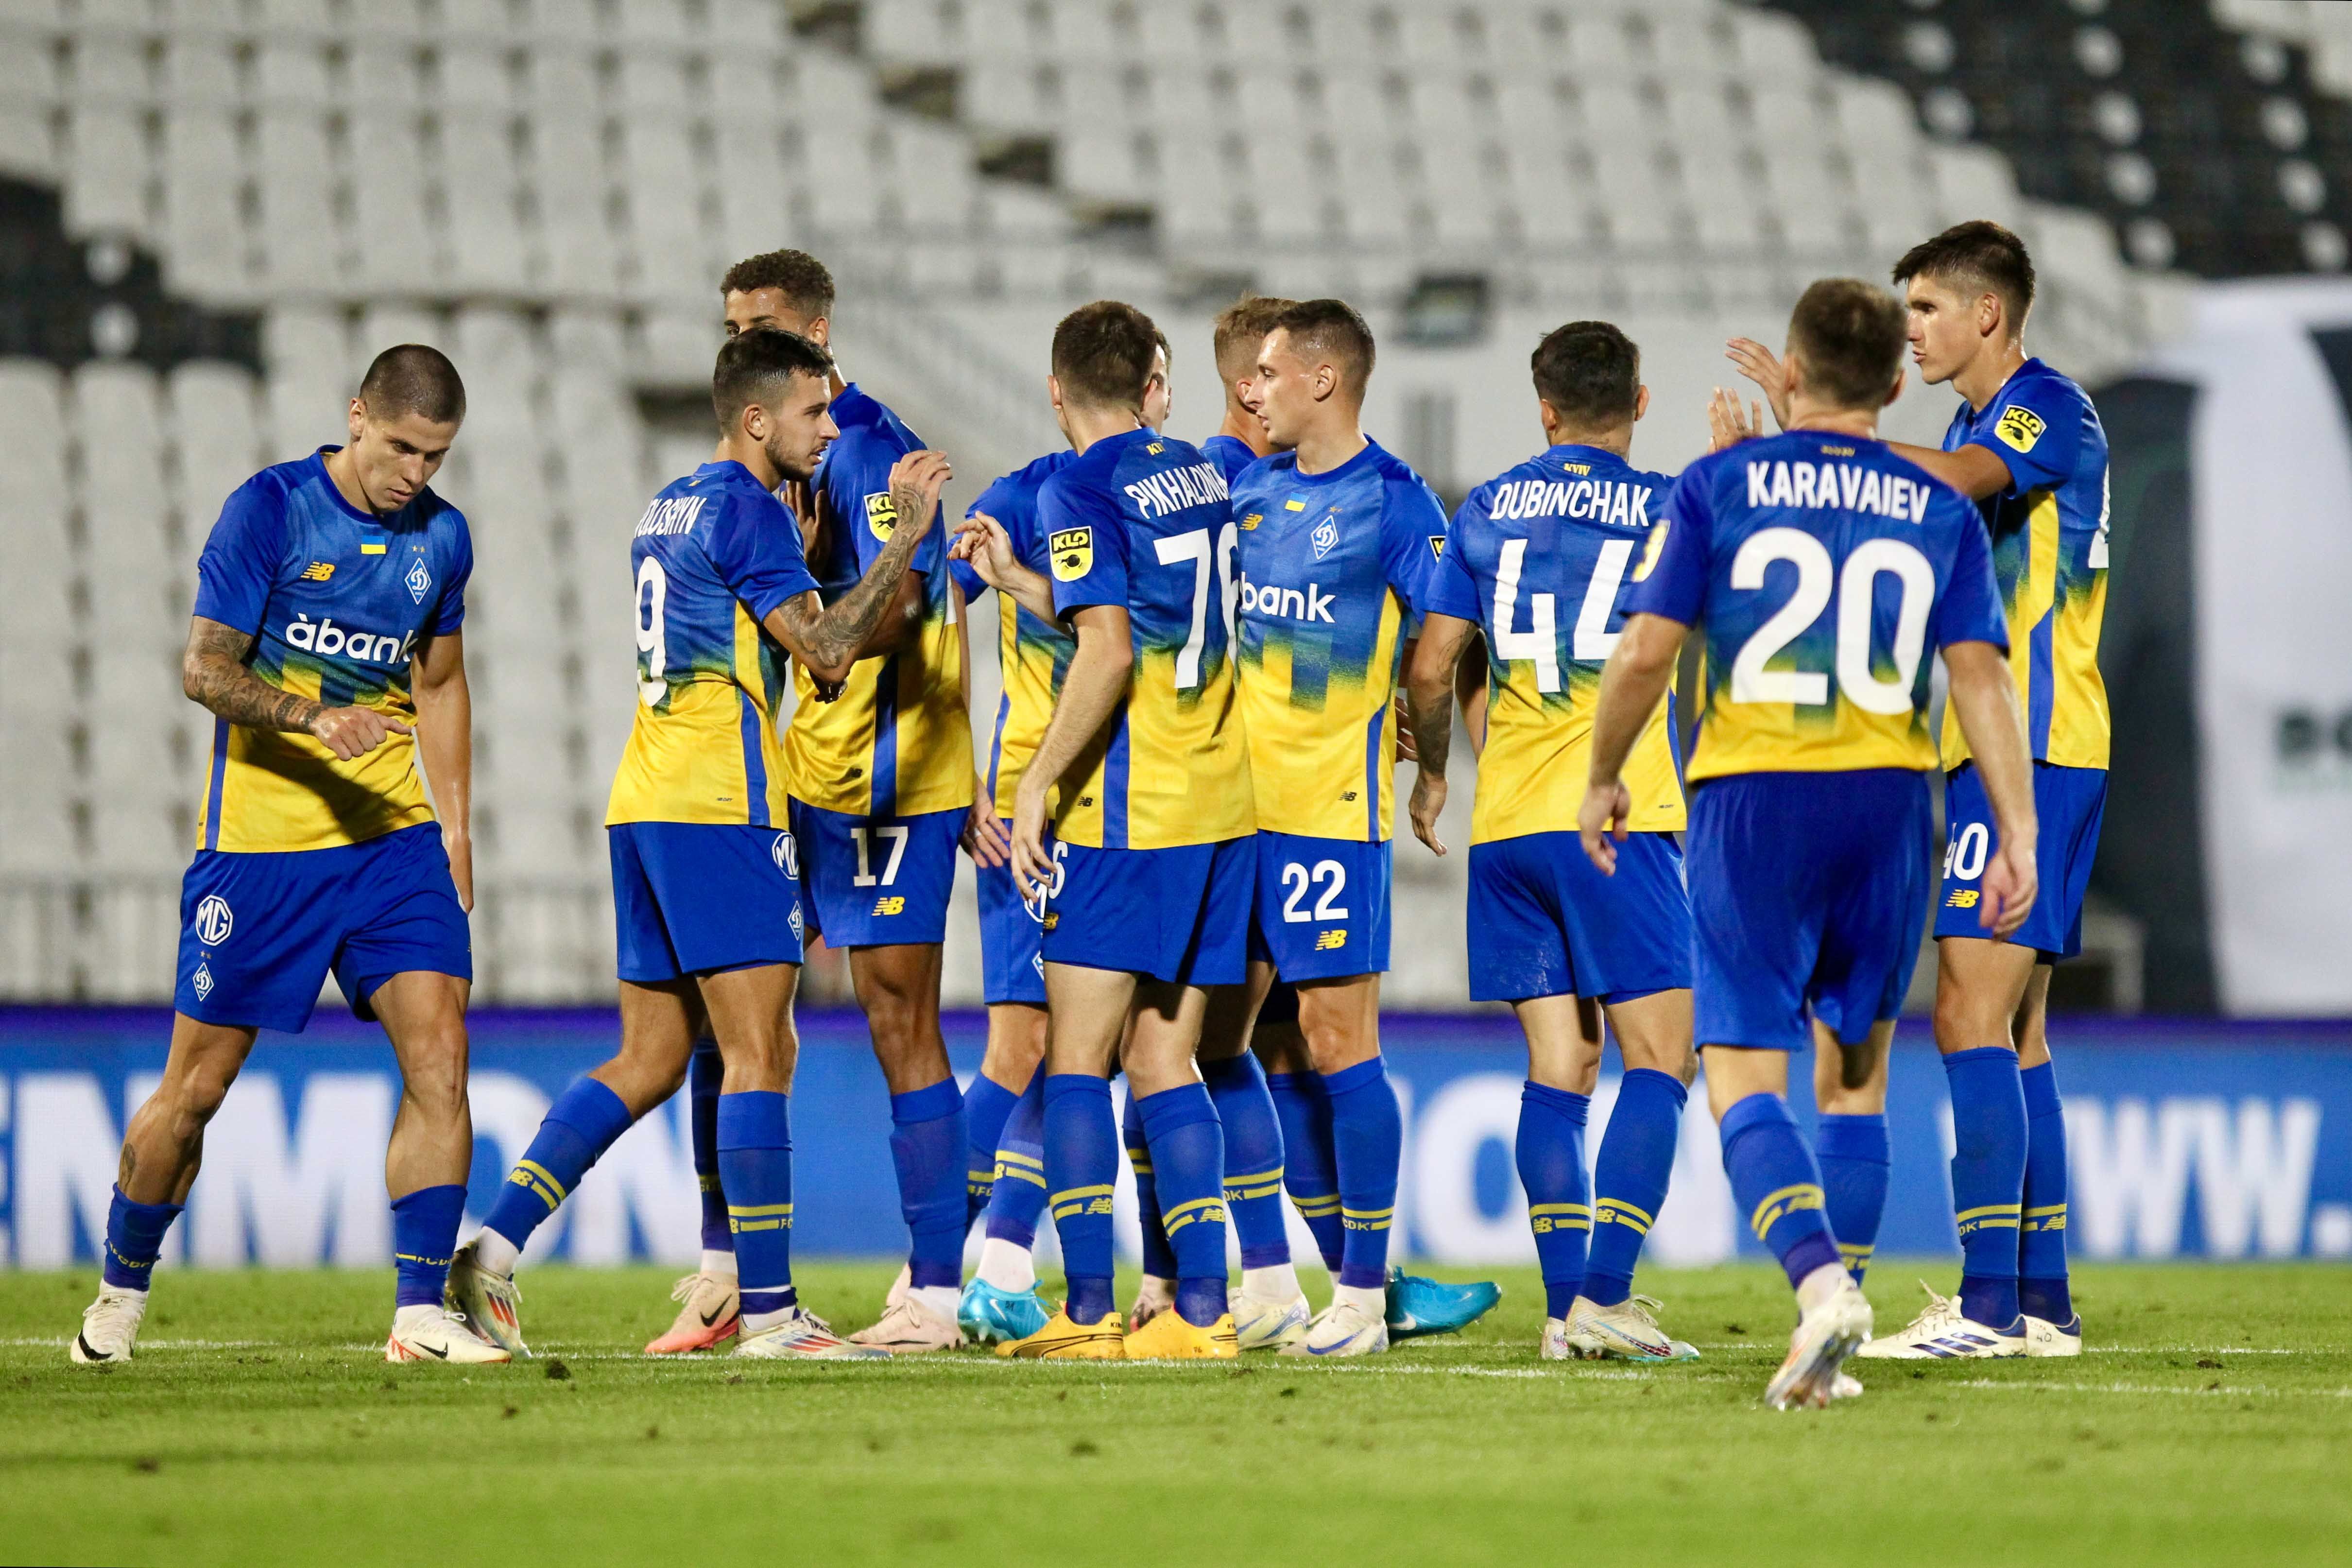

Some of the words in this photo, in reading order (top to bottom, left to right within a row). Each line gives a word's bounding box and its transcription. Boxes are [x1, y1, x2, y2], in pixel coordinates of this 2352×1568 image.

[1563, 463, 1591, 476] KYIV
[869, 496, 894, 513] KL
[1490, 480, 1652, 527] DUBINCHAK
[1747, 460, 1931, 525] KARAVAIEV
[1053, 532, 1088, 552] KLO
[1240, 571, 1336, 623] bank
[635, 555, 667, 706] 9
[1730, 527, 1936, 716] 20
[851, 827, 909, 887] 17
[1282, 860, 1349, 923] 22
[197, 899, 228, 942] MG
[1224, 1190, 1243, 1202] DK
[1342, 1218, 1369, 1231] CDK
[1958, 1221, 1977, 1237] DK
[2036, 1332, 2052, 1343] 40
